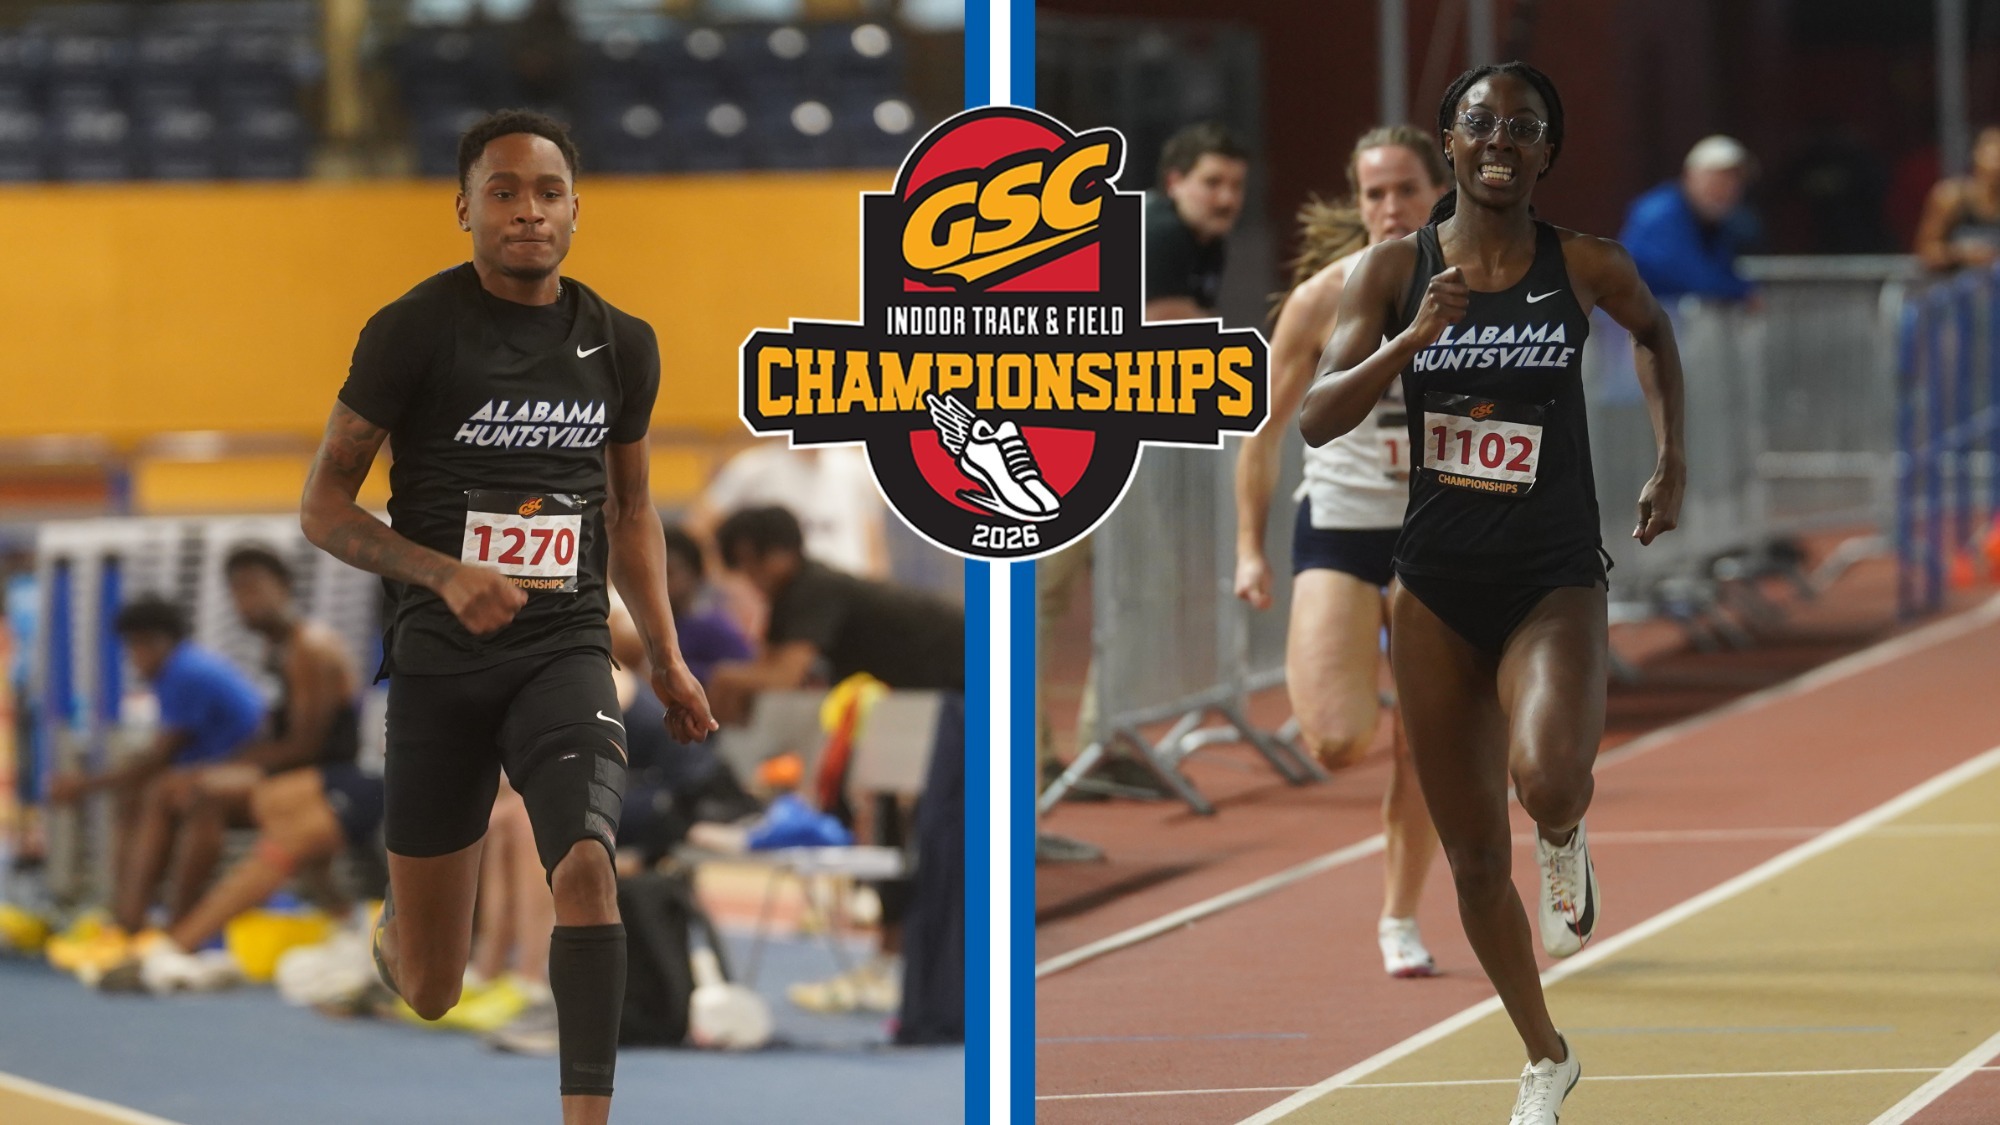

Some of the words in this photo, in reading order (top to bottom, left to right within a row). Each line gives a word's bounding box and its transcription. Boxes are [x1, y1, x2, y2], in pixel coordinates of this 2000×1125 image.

[1430, 322, 1566, 346] LABAMA
[1413, 346, 1576, 373] HUNTSVILLE
[469, 398, 606, 425] ALABAMA
[1470, 403, 1495, 419] GSC
[454, 423, 610, 449] HUNTSVILLE
[1432, 425, 1534, 473] 1102
[1438, 473, 1518, 494] CHAMPIONSHIPS
[518, 497, 543, 516] GSC
[474, 525, 575, 566] 1270
